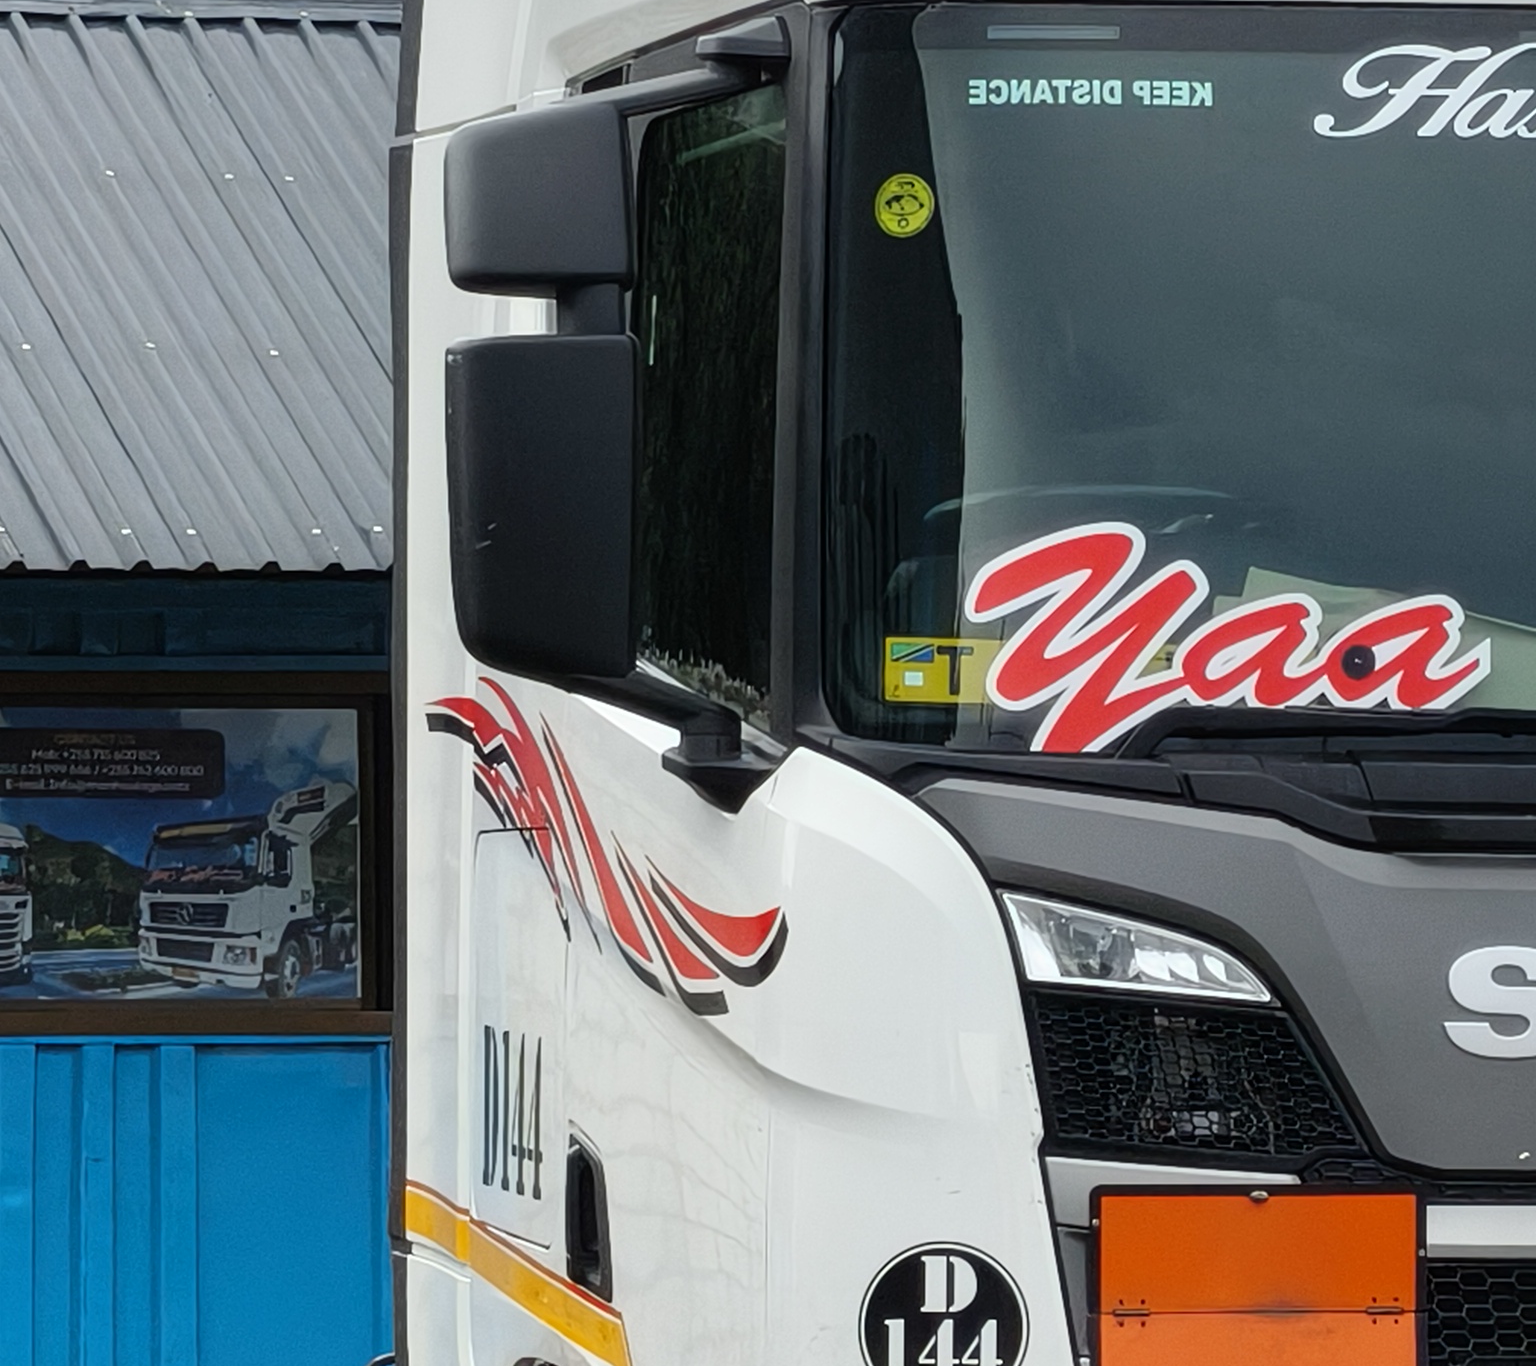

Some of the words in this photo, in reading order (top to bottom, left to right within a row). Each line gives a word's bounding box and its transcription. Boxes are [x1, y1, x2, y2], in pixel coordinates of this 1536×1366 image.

[964, 521, 1492, 753] Yaa
[482, 1025, 543, 1201] D144
[919, 1255, 979, 1314] D
